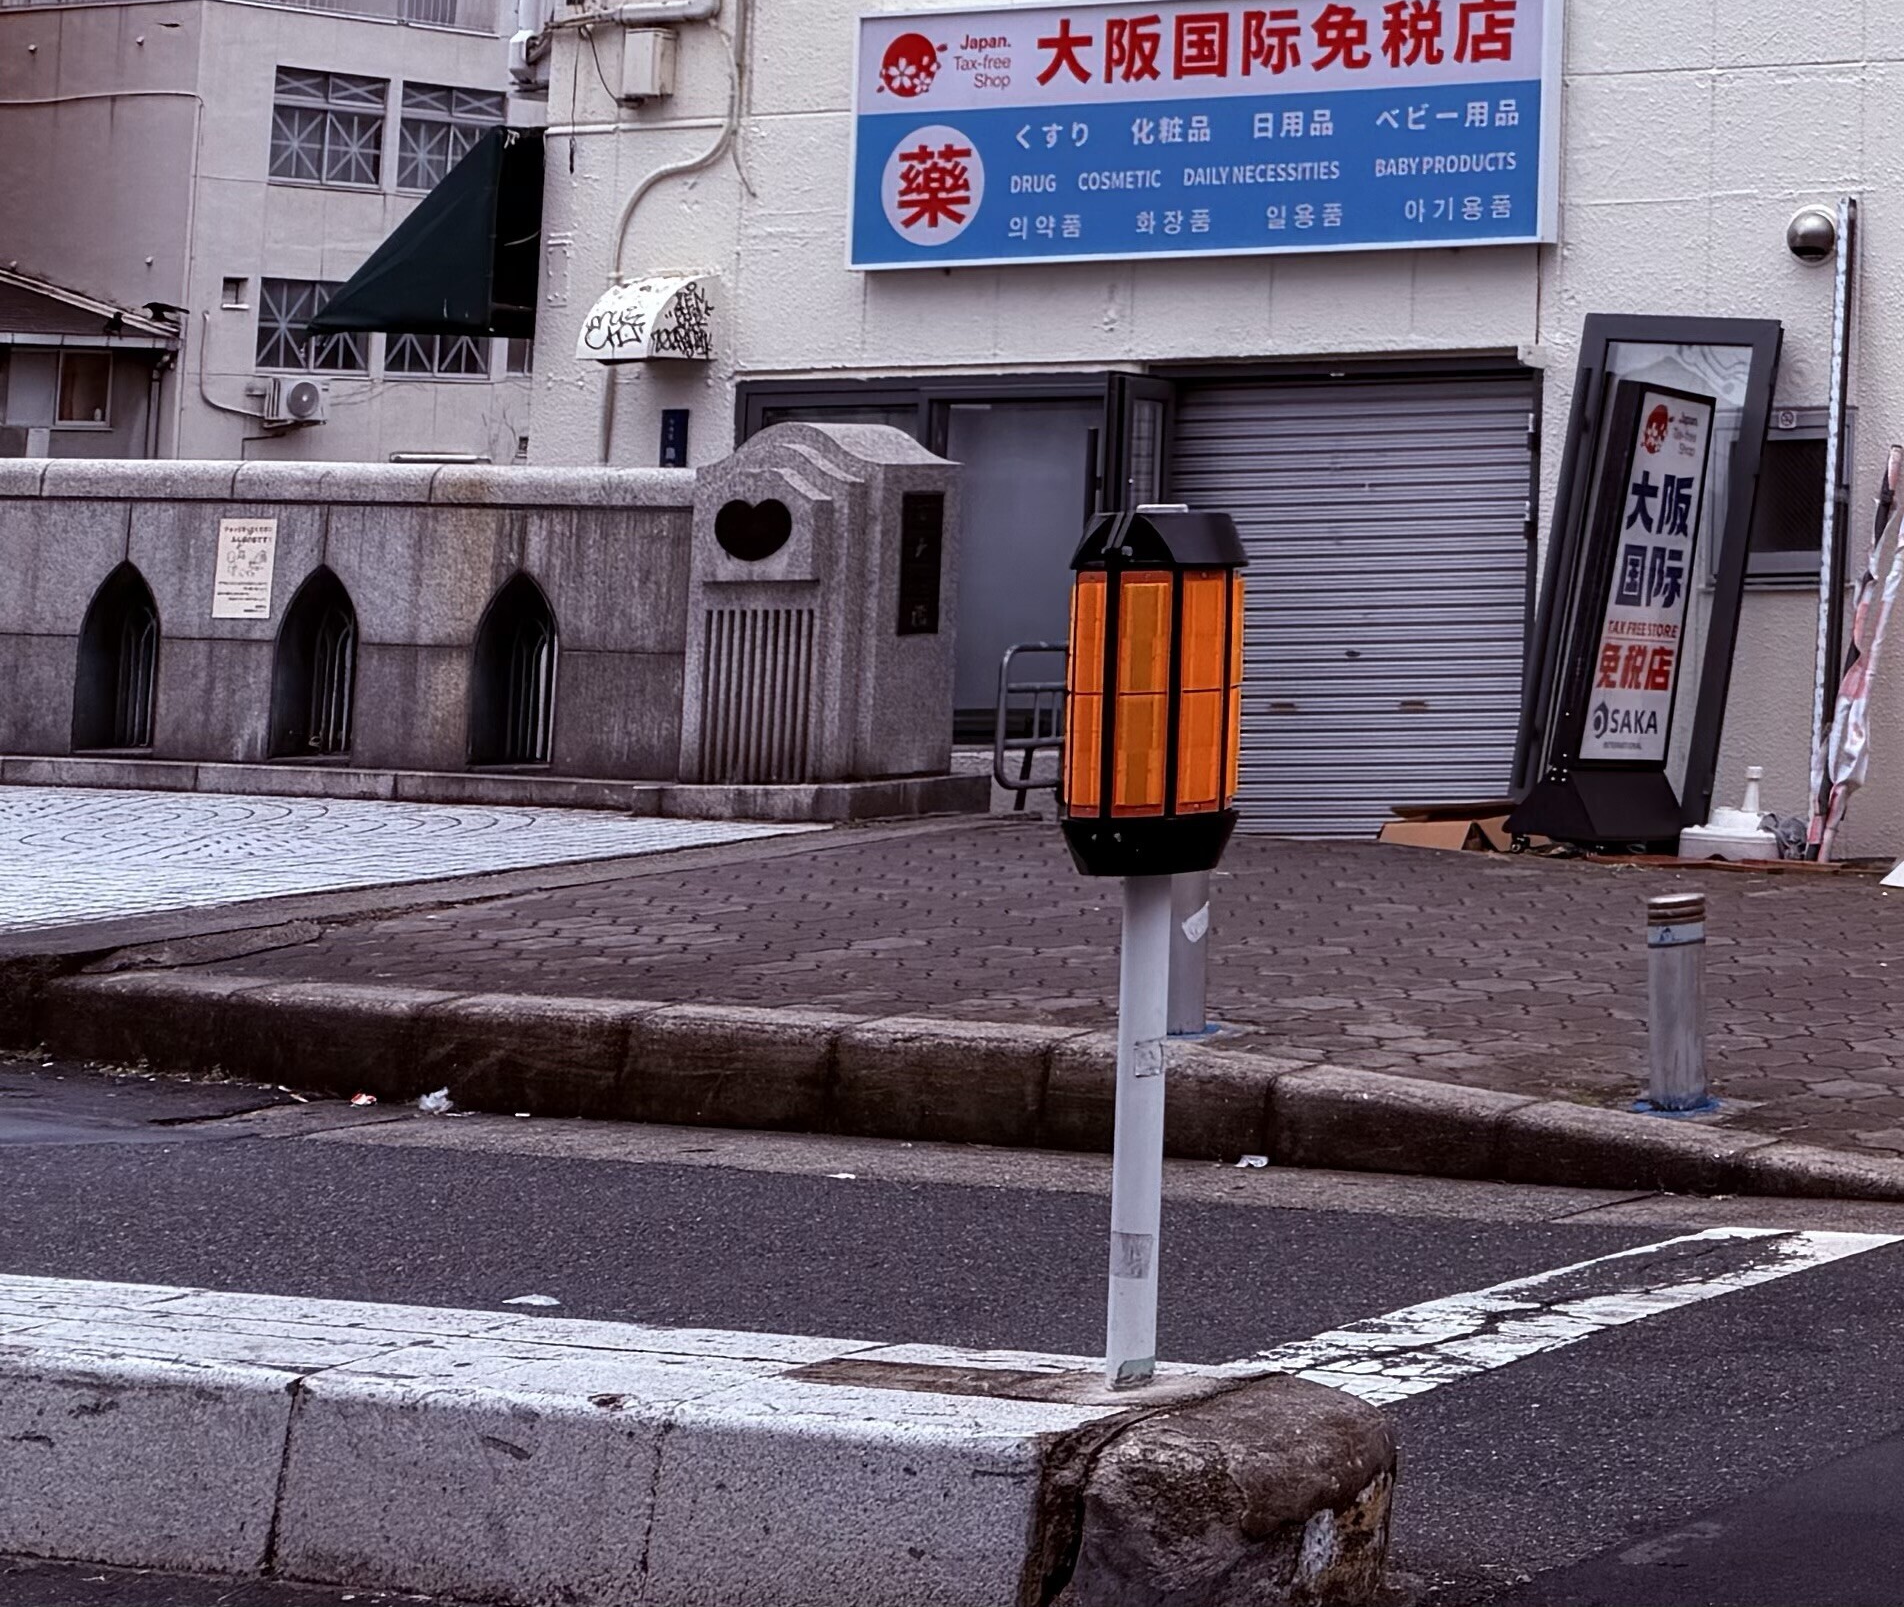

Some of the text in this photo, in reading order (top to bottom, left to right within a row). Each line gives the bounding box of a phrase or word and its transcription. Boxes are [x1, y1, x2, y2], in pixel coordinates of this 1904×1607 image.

[953, 54, 1011, 71] Tax-free
[960, 34, 1011, 53] Japan.
[974, 73, 1011, 90] Shop
[1015, 99, 1519, 150] くすり 化粧品 日用品 ベビー用品
[1010, 152, 1517, 194] DRUG COSMETIC DAILY NECESSITIES BABY PRODUCTS
[1008, 194, 1512, 240] 의약품 화장품 일용품 아기용품
[1626, 470, 1694, 537] 大阪
[1615, 544, 1684, 608] 国际
[1608, 620, 1679, 639] TAX FREE STORE
[1596, 643, 1675, 691] 免税店
